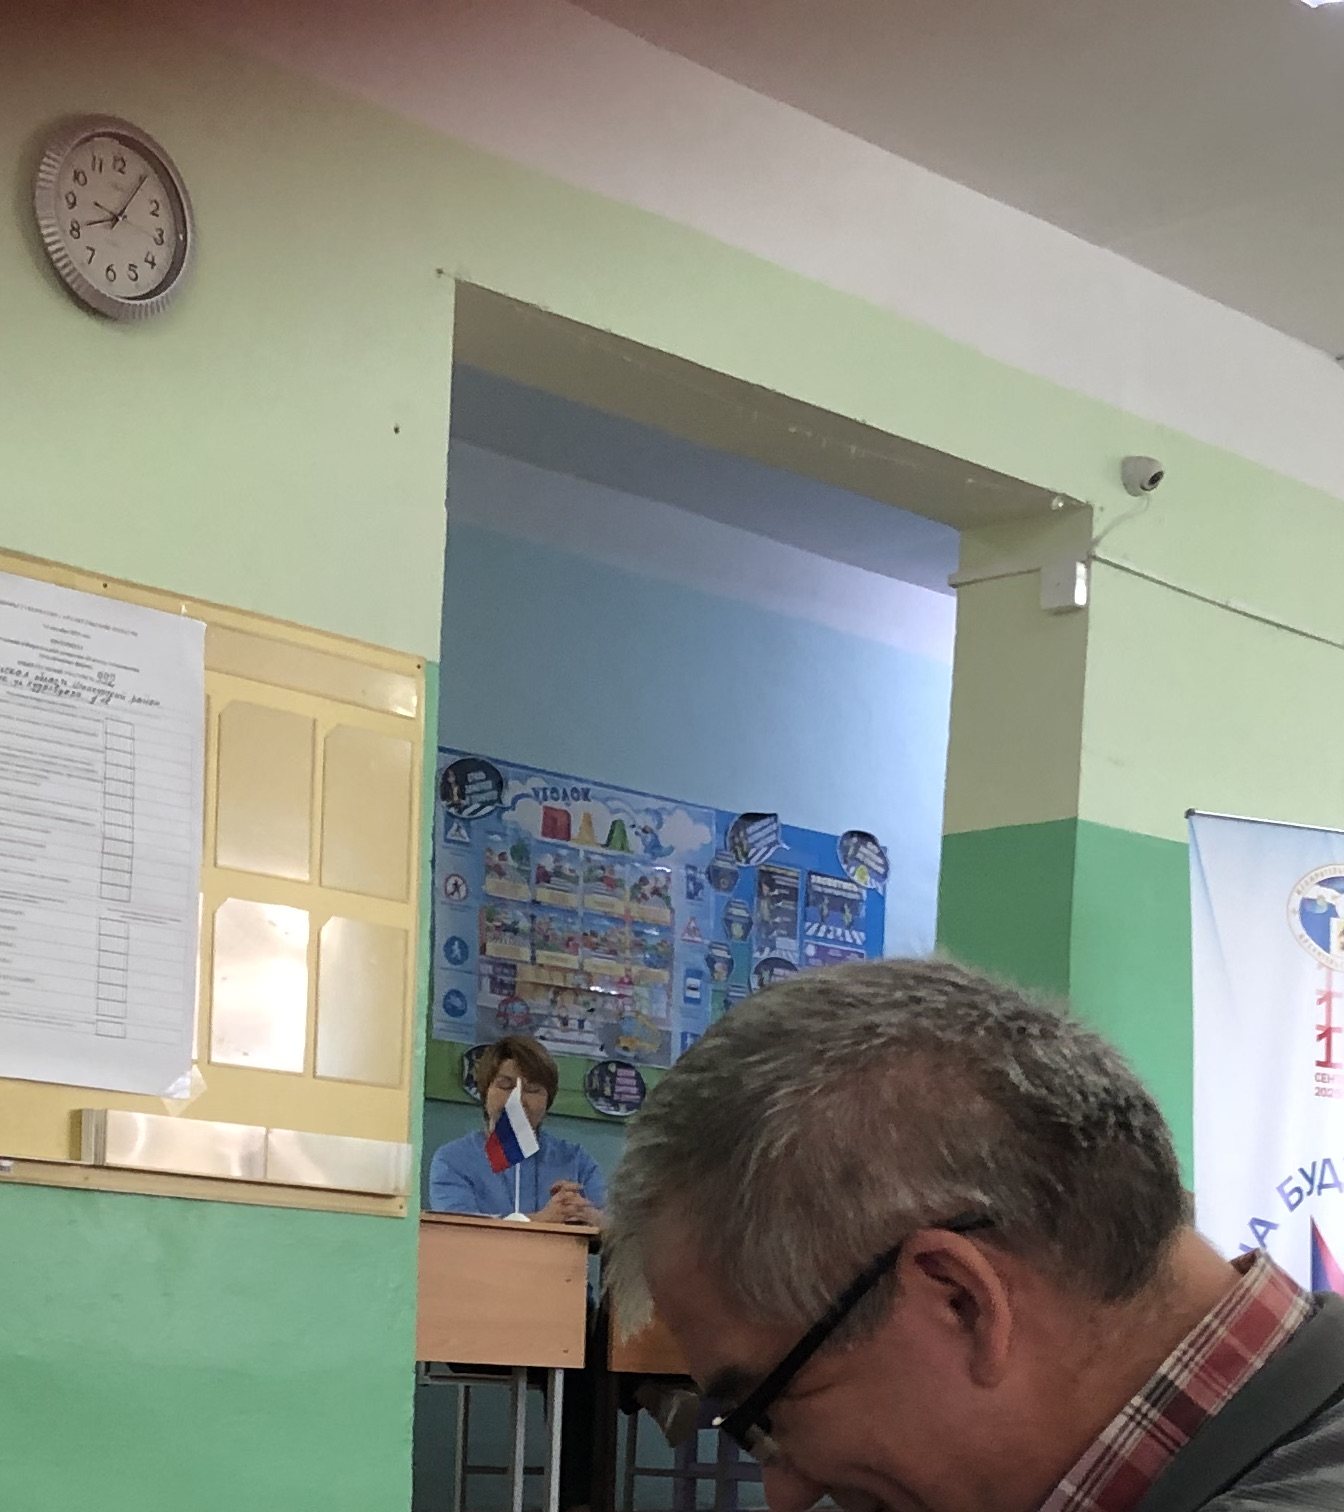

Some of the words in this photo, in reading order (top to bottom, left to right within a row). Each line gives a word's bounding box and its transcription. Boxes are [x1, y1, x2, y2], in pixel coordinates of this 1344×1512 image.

[91, 154, 103, 174] 11
[112, 155, 126, 175] 12
[73, 168, 88, 187] 10
[65, 190, 77, 209] 9
[149, 199, 160, 217] 2
[69, 218, 81, 239] 8
[153, 228, 165, 246] 3
[86, 245, 96, 265] 7
[144, 251, 156, 270] 4
[105, 263, 117, 283] 6
[126, 263, 139, 282] 5
